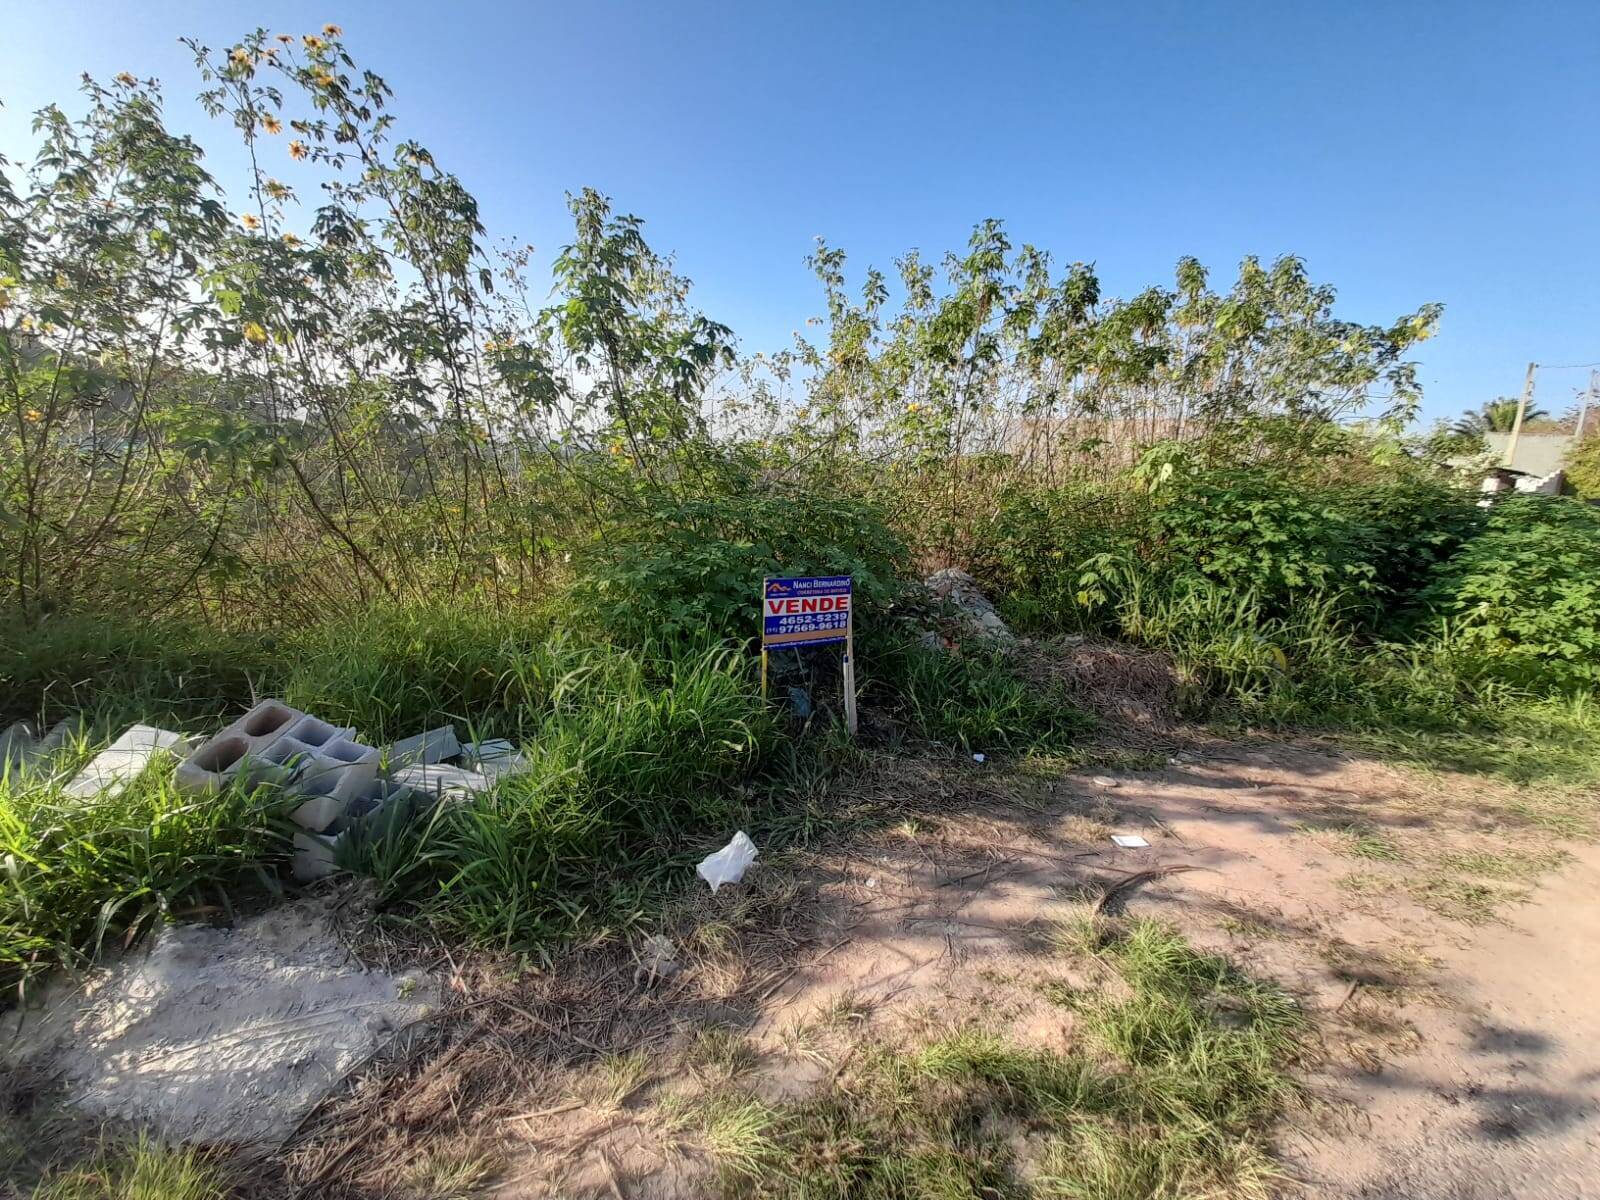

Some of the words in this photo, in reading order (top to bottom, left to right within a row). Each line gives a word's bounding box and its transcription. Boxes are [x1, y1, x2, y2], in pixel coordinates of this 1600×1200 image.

[793, 580, 812, 589] NANCI
[768, 597, 849, 615] VENDE
[779, 612, 847, 625] 4652-5239
[779, 621, 847, 634] 97569-9618
